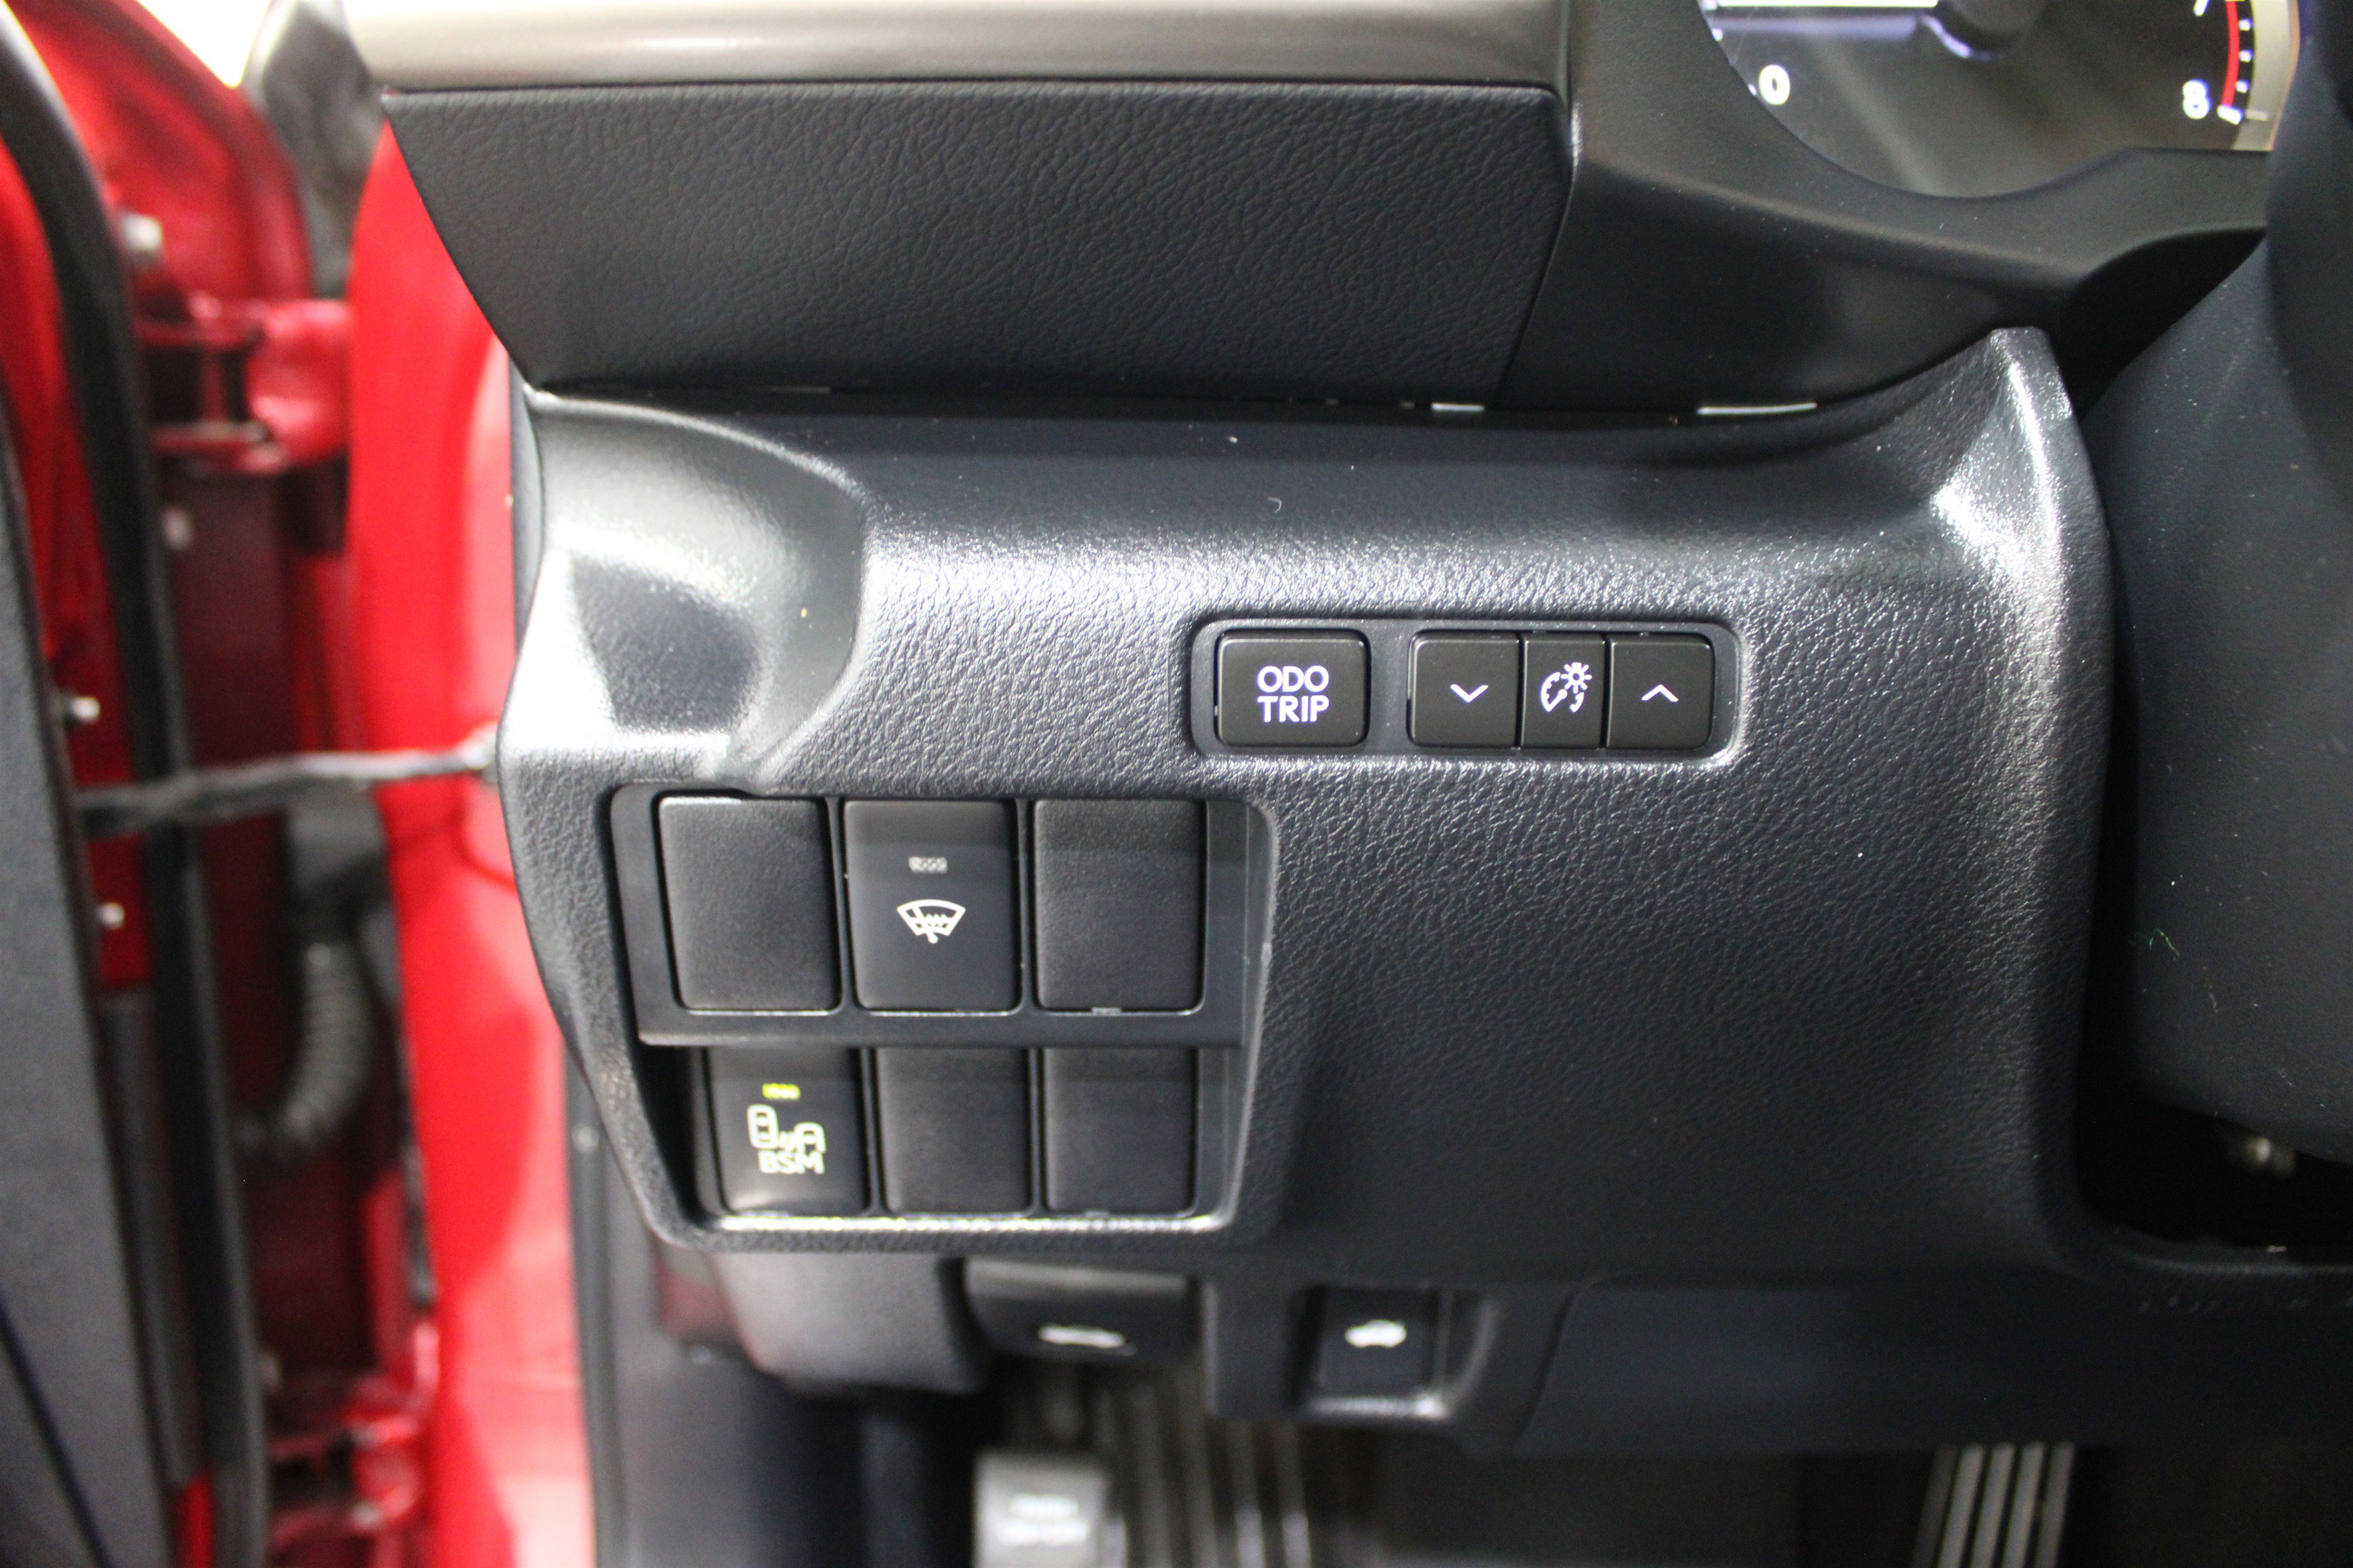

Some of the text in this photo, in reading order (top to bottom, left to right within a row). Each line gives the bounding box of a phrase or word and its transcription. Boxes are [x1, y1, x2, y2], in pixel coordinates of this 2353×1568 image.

[1758, 64, 1791, 106] 0
[2181, 78, 2212, 119] 8
[1257, 665, 1329, 693] ODO
[1256, 694, 1330, 723] TRIP
[758, 1149, 826, 1174] BSM
